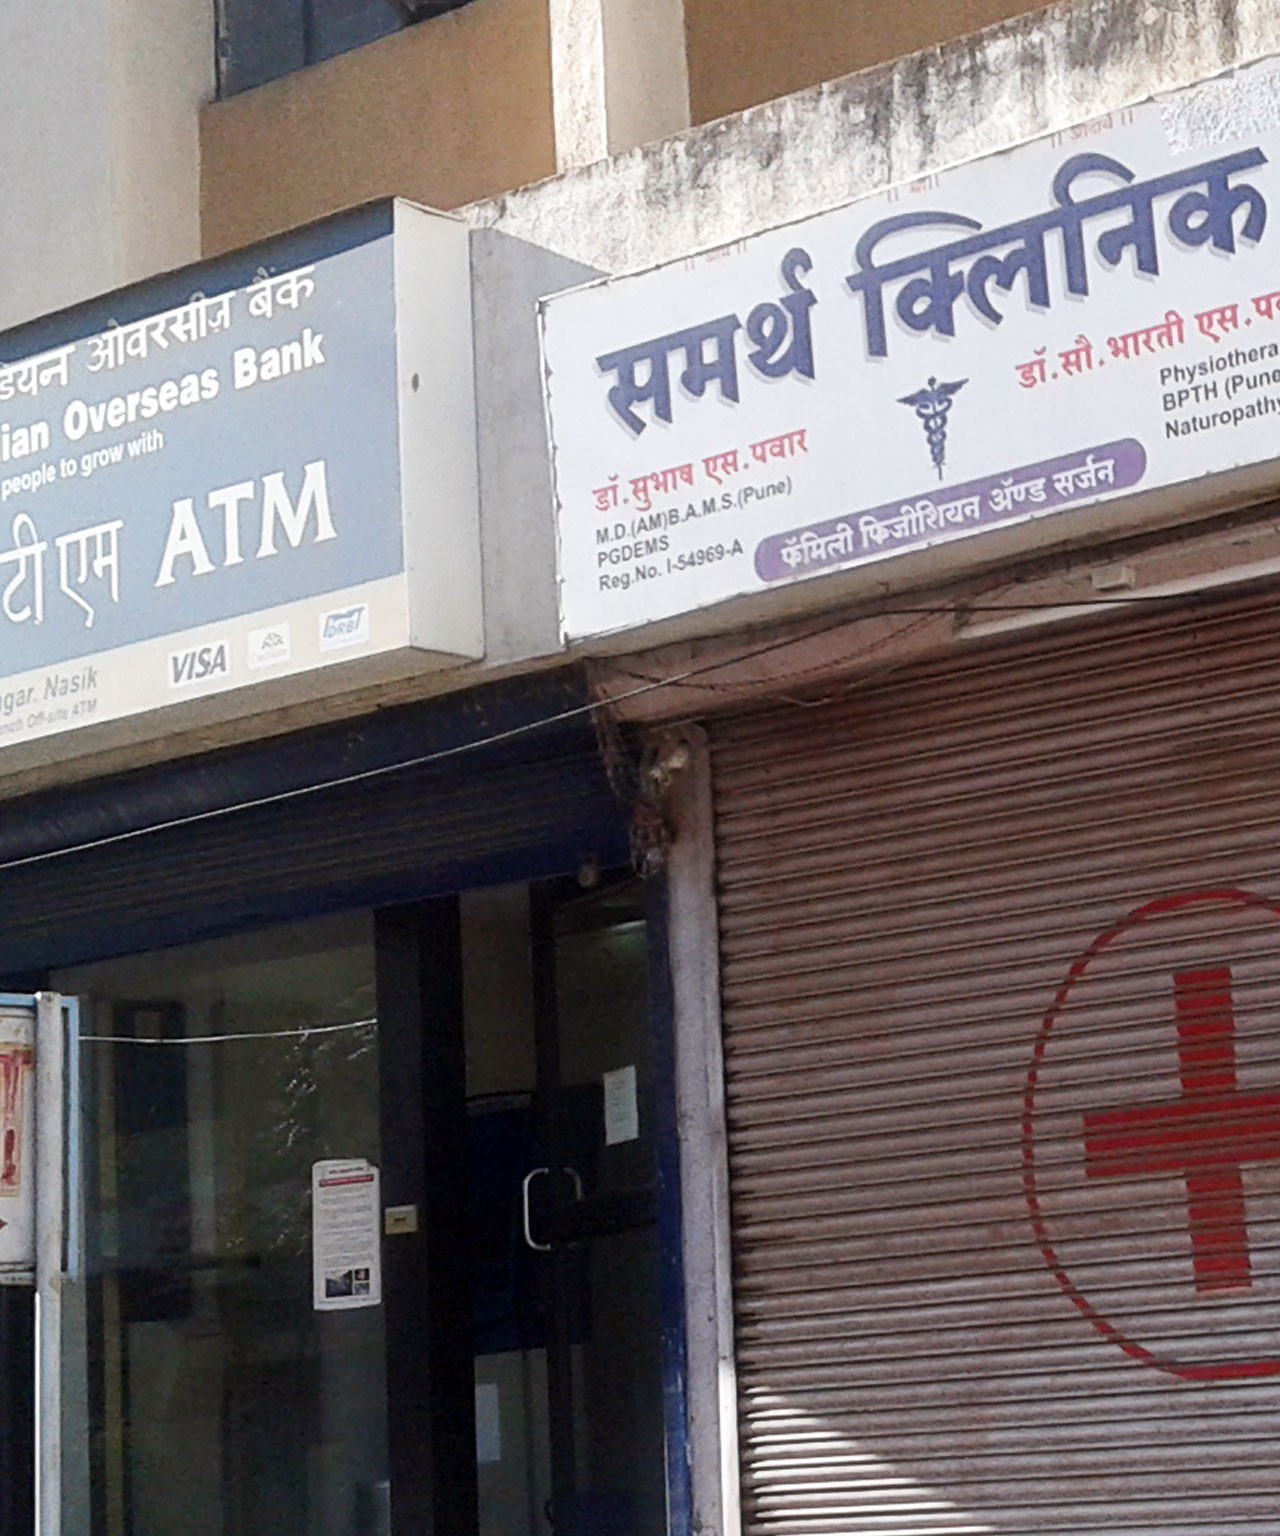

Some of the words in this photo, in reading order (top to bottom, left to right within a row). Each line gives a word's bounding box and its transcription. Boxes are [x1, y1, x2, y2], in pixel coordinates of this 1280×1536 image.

[245, 266, 315, 318] बैंक
[595, 247, 818, 437] समर्थ
[846, 147, 1268, 357] क्लिनिक
[1, 420, 49, 462] ian
[64, 369, 219, 440] Overseas
[234, 328, 325, 389] Bank
[1162, 381, 1218, 412] BPTH
[2, 462, 56, 501] people
[60, 458, 77, 478] to
[81, 445, 124, 477] grow
[127, 428, 164, 457] with
[1052, 454, 1115, 497] सर्जन
[155, 460, 338, 587] ATM
[0, 513, 47, 626] टी
[56, 519, 123, 628] एम
[598, 534, 669, 569] PGDEMS
[667, 539, 744, 574] I-54969-A
[43, 666, 97, 700] Nasik
[172, 644, 227, 684] VISA
